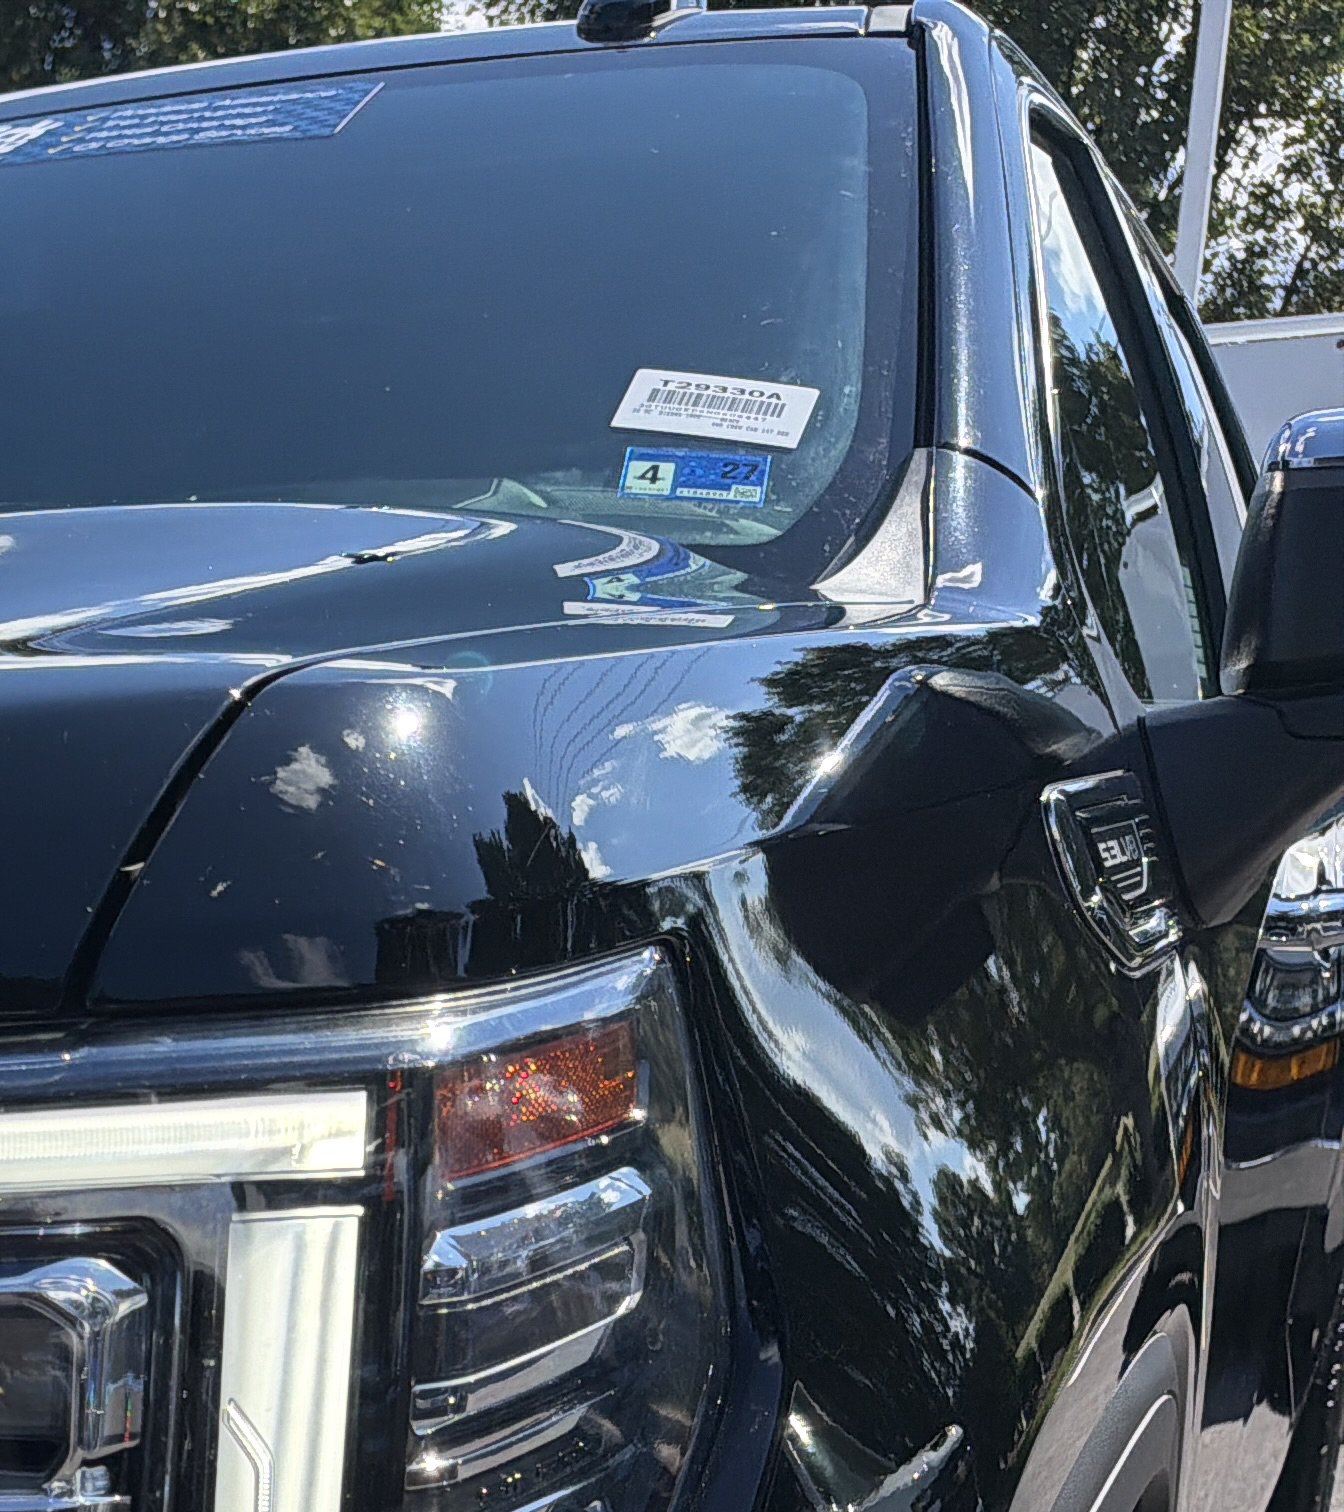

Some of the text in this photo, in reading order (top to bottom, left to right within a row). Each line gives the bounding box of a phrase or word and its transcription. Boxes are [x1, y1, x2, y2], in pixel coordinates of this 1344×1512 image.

[662, 380, 782, 401] T29330A
[634, 462, 760, 485] 4 27
